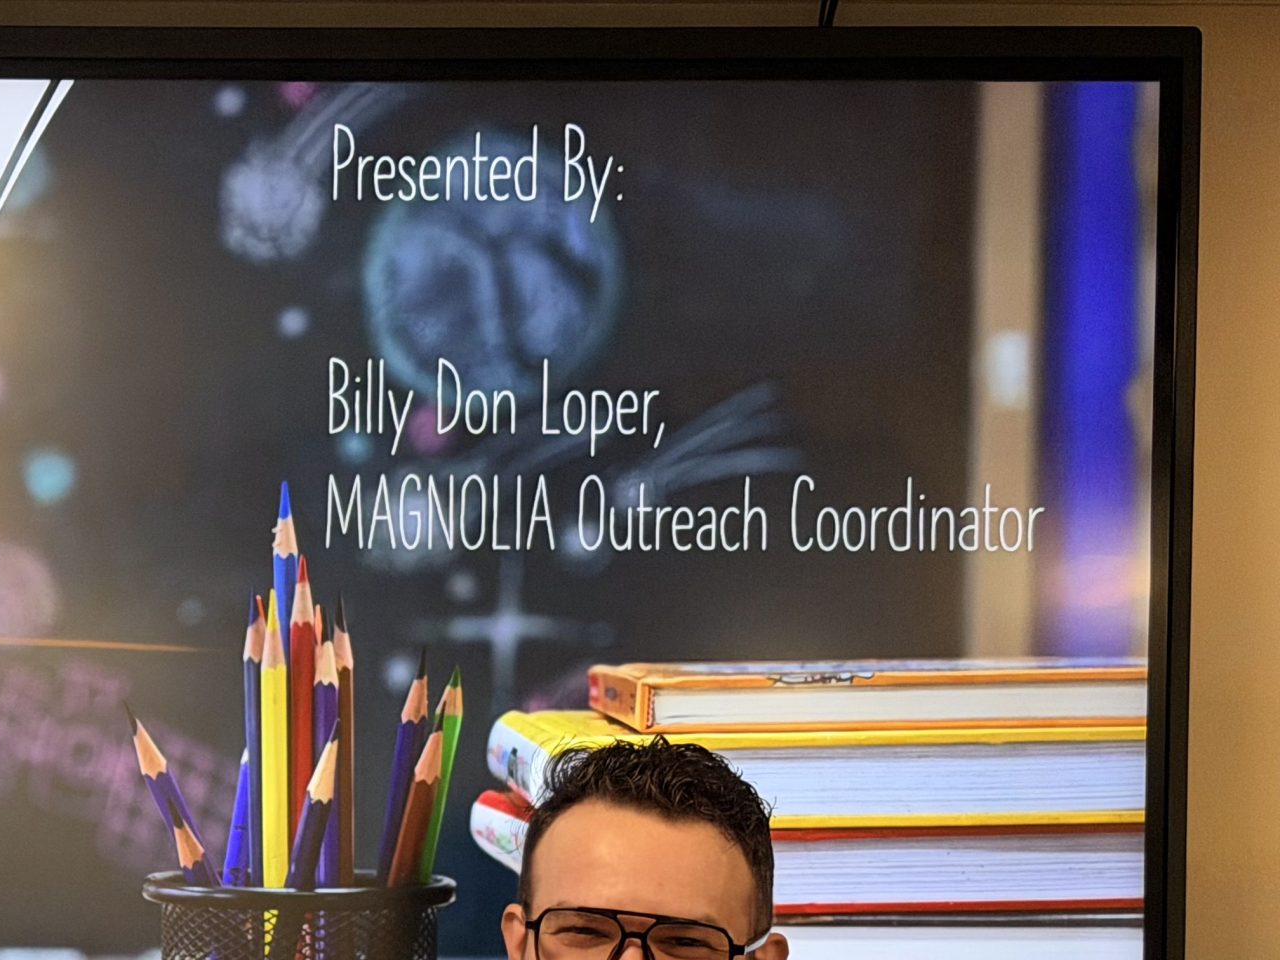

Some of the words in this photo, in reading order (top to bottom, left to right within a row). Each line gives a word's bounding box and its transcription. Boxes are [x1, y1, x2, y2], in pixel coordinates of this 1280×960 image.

[331, 123, 539, 202] Presented
[563, 123, 626, 223] By:
[327, 357, 415, 456] Billy
[434, 357, 517, 436] Don
[540, 358, 666, 457] Loper,
[324, 473, 556, 552] MAGNOLIA
[577, 474, 768, 553] Outreach
[790, 475, 1045, 553] Coordinator
